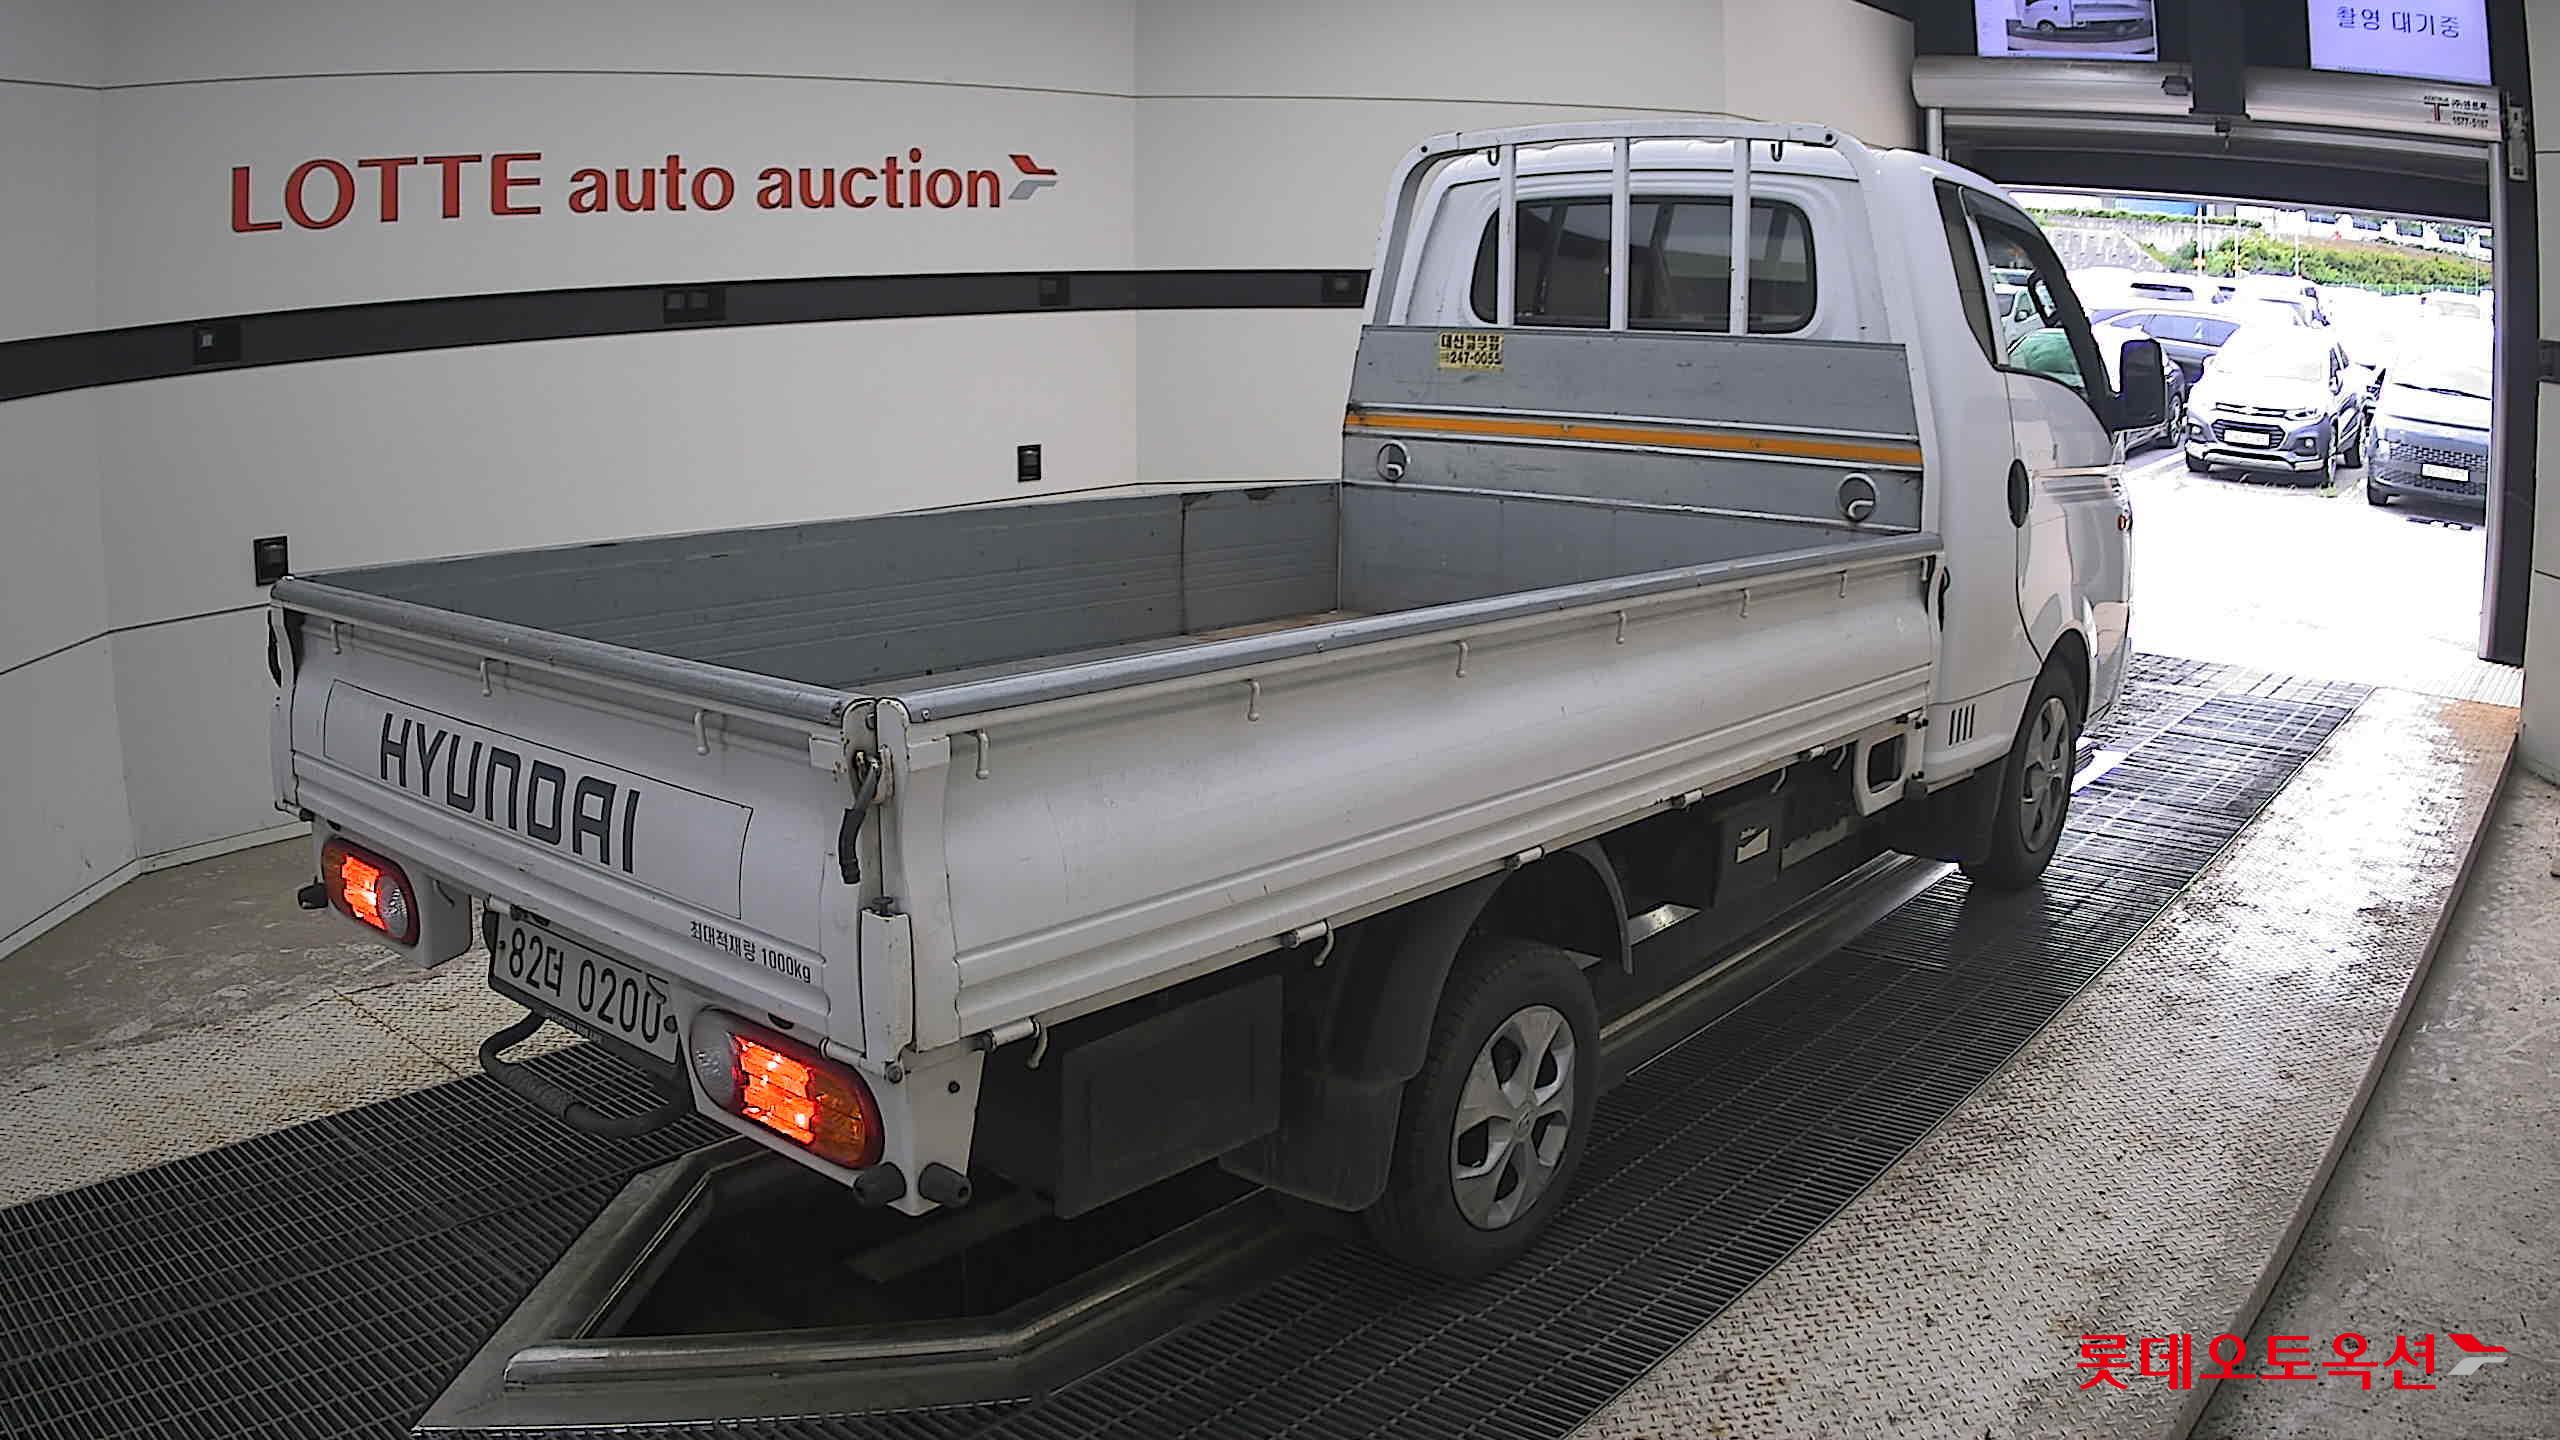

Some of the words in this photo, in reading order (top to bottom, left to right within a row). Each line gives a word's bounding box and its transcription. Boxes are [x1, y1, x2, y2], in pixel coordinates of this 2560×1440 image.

[2337, 6, 2380, 31] 촬영
[2392, 11, 2460, 39] 대기중
[231, 151, 543, 233] LOTTE
[567, 153, 736, 214] auto
[757, 148, 1002, 210] auction
[380, 712, 641, 874] HYUNDAI
[690, 920, 756, 962] 최대적재량
[509, 927, 564, 997] 82더
[577, 959, 663, 1044] 0200
